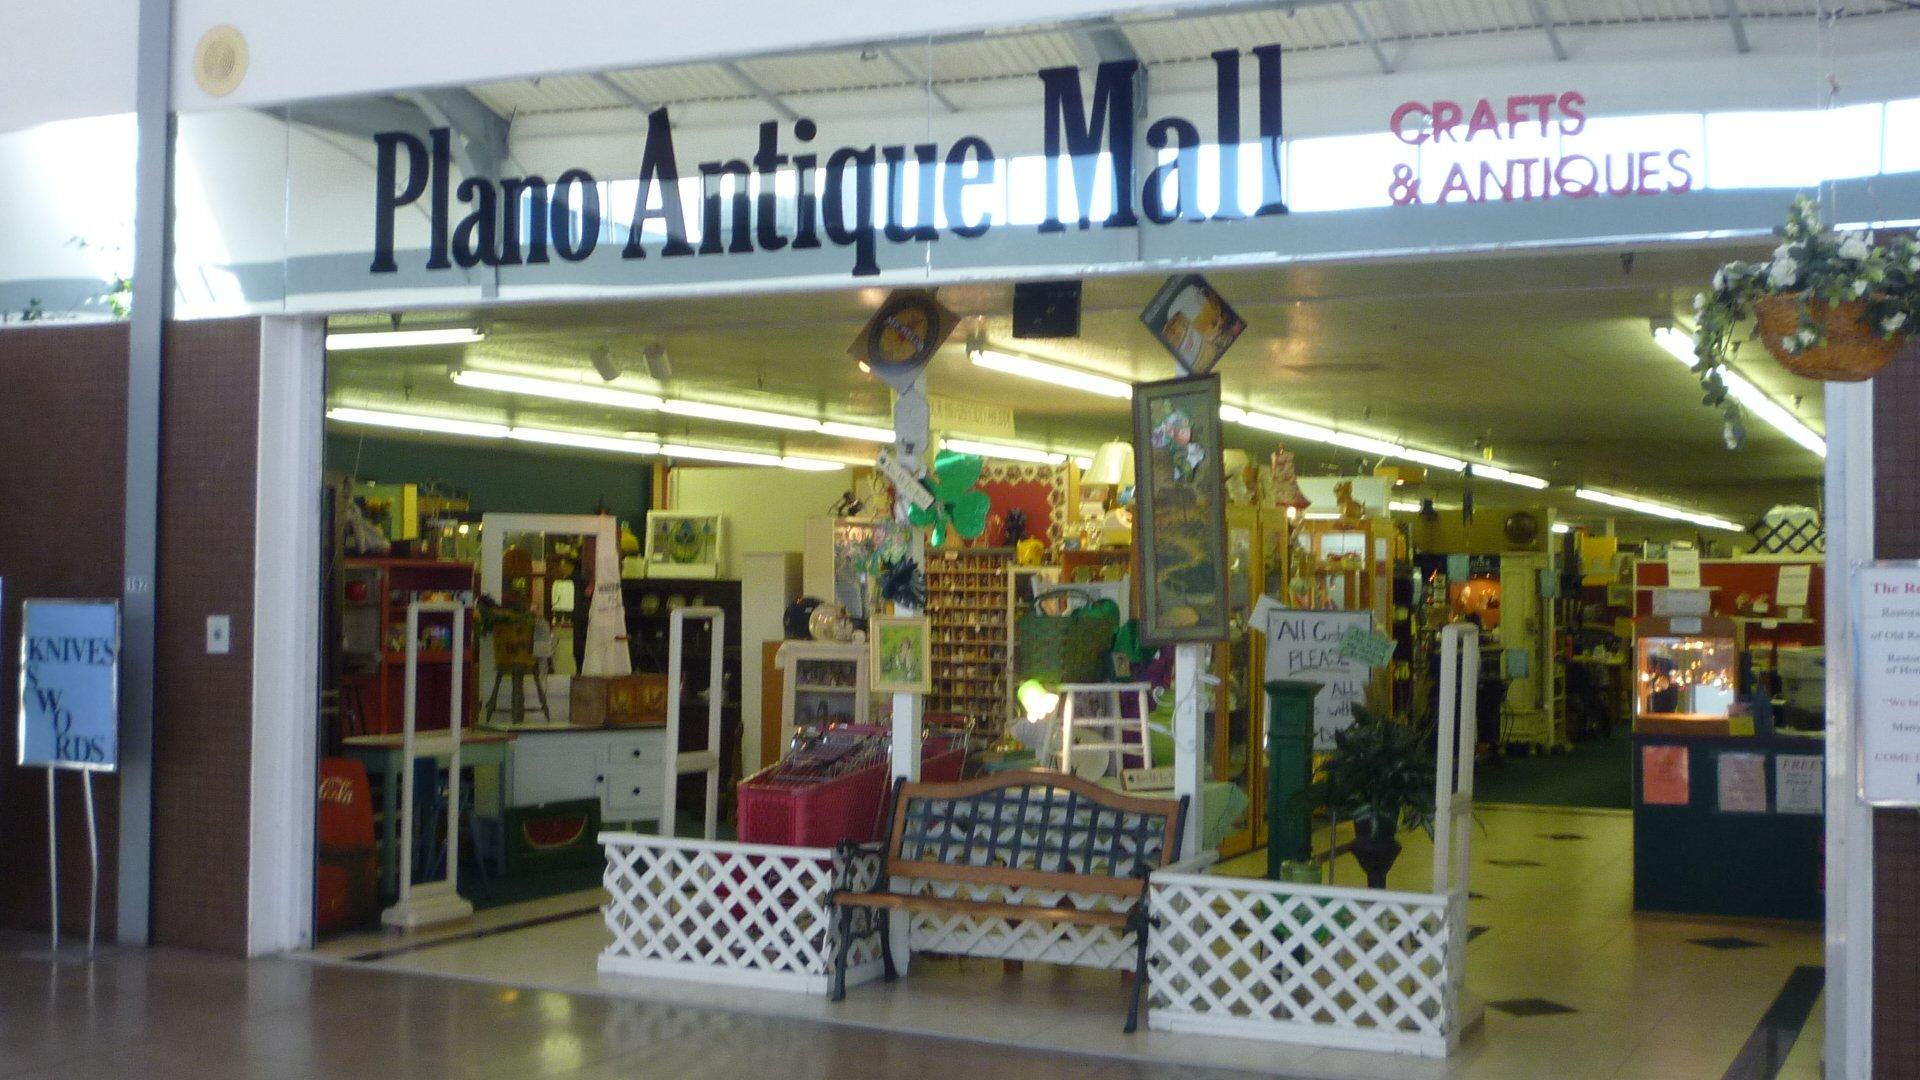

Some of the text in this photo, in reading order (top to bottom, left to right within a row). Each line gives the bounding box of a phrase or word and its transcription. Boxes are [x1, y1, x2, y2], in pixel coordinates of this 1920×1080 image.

[1390, 91, 1587, 145] CRAFTS
[371, 43, 1289, 276] Plano Antique Mall
[1389, 149, 1694, 207] & ANTIQUES
[29, 636, 115, 666] KNIVES
